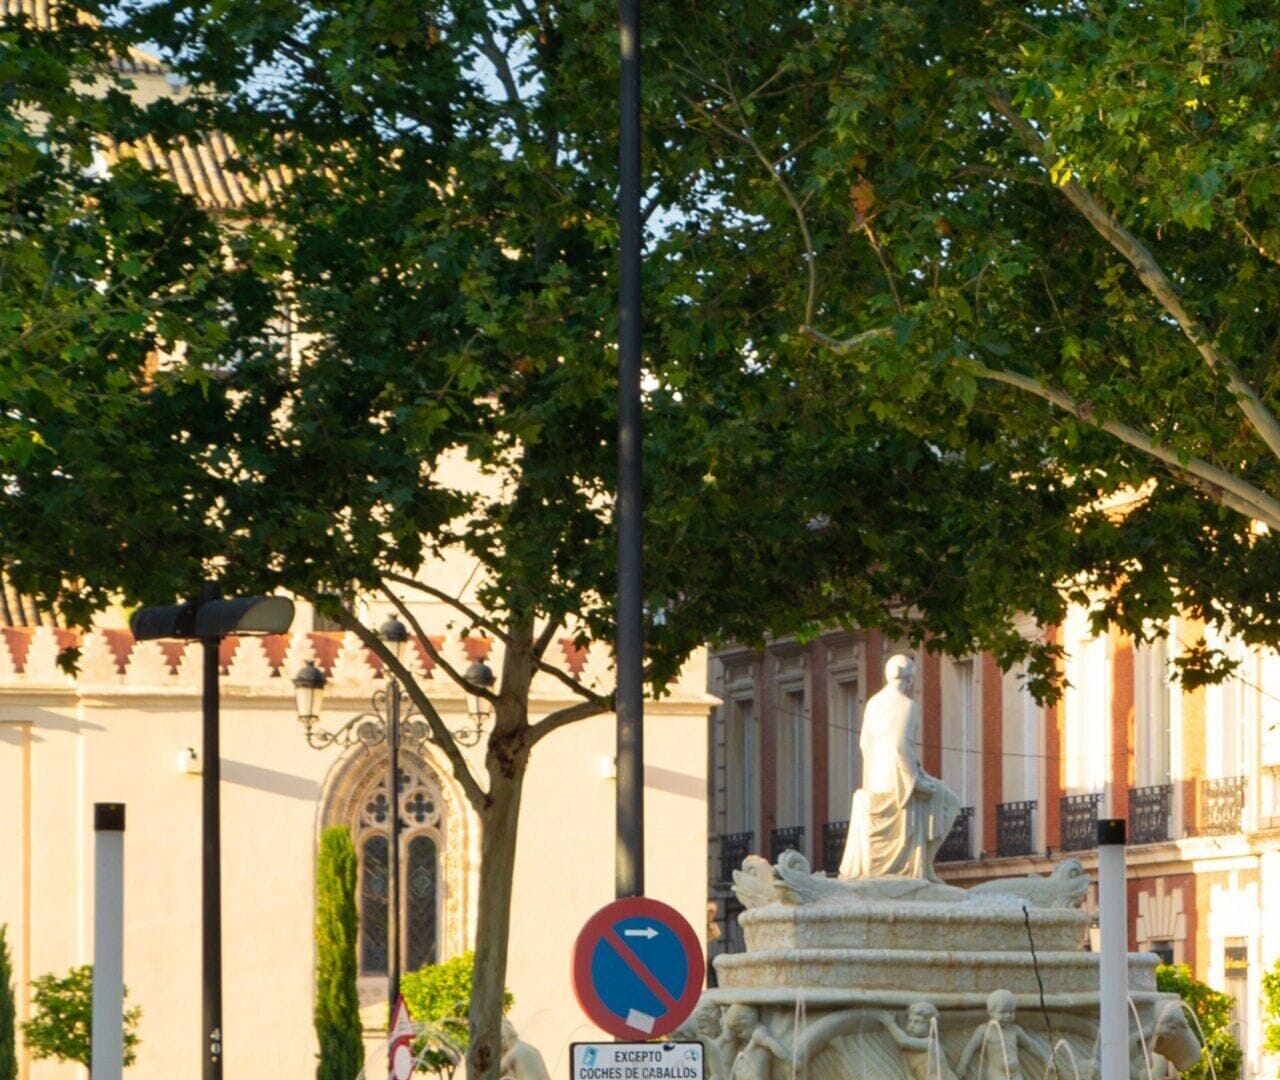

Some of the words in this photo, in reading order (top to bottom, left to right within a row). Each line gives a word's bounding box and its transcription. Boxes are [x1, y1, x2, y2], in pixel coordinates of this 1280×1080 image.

[615, 1051, 662, 1062] EXCEPTO
[580, 1068, 622, 1080] COCHES
[625, 1068, 639, 1079] DE
[642, 1067, 697, 1079] CABALLOS
